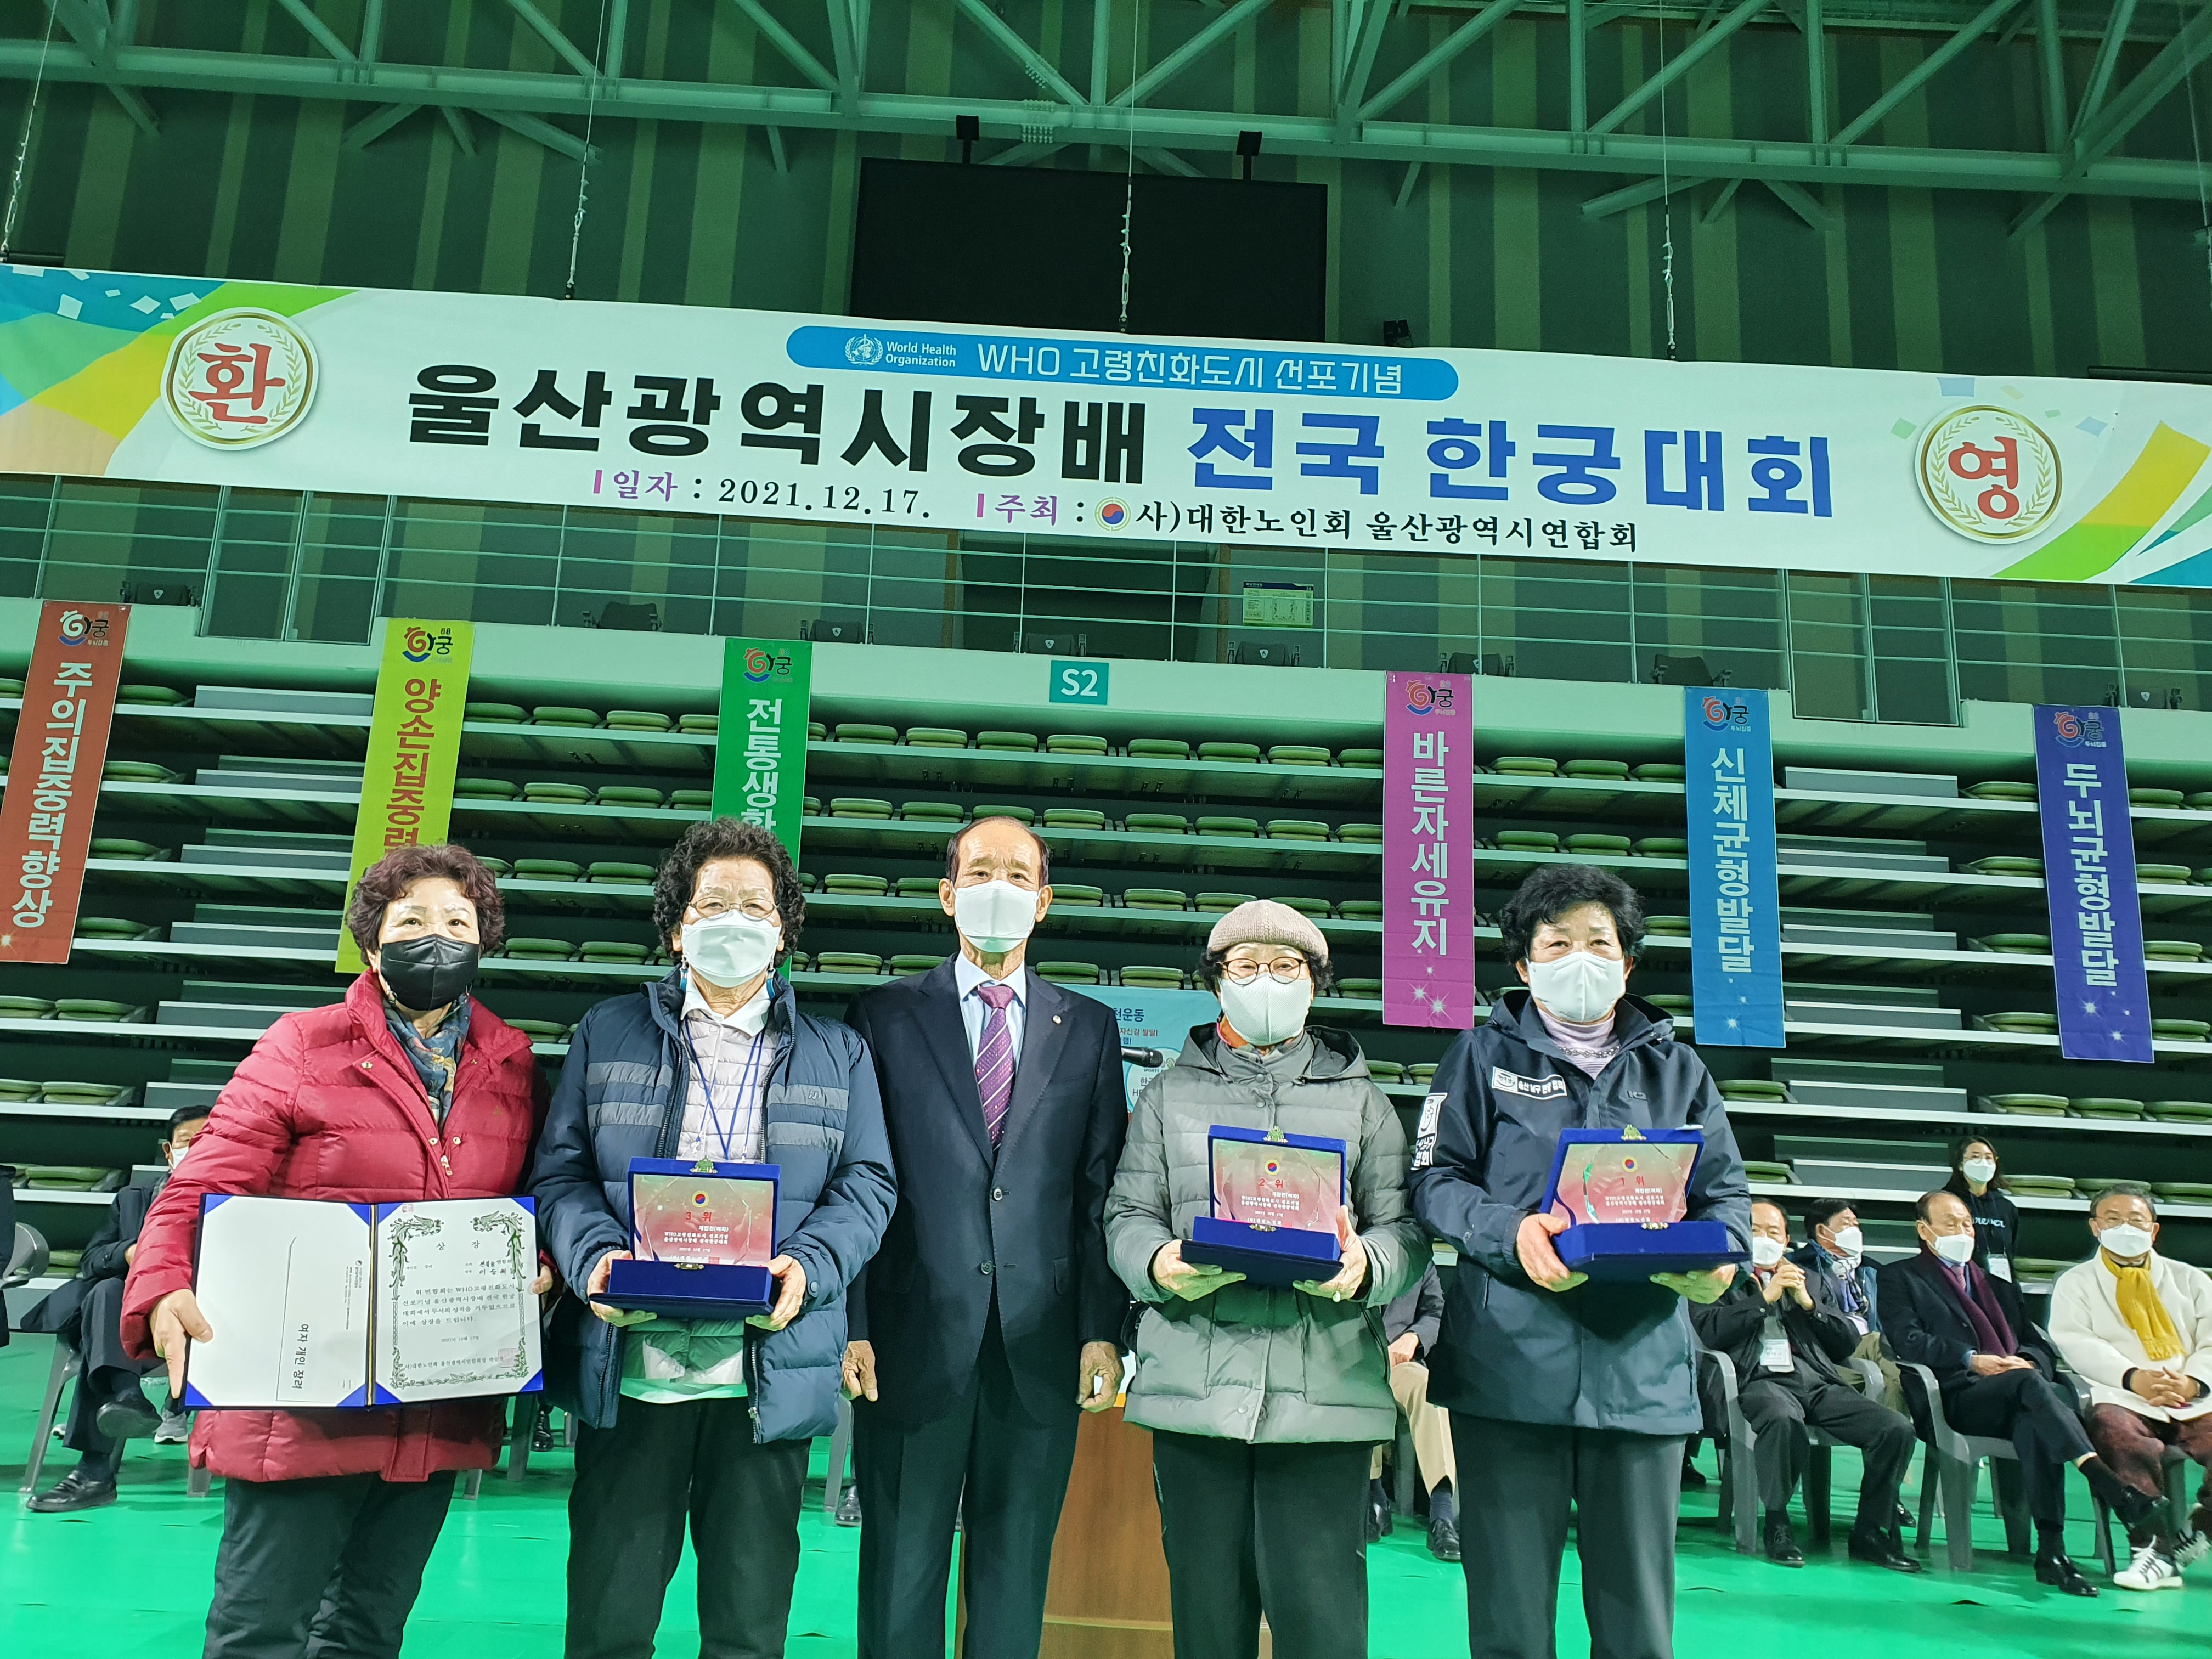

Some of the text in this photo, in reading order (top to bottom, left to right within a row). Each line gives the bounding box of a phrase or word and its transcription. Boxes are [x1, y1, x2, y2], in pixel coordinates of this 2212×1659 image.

[885, 353, 956, 368] Organization
[886, 341, 956, 356] World Health
[978, 343, 1402, 394] WHO 고령친화도시 선포기념
[188, 341, 286, 425] 환
[408, 364, 1834, 517] 울산광역시장배 전국 한궁대회
[613, 470, 679, 503] 일자
[718, 478, 930, 518] 2021.12.17.
[1948, 435, 2022, 521] 영
[994, 494, 1058, 526] 주최
[1135, 500, 1351, 540] 사)대한노인회
[1365, 510, 1637, 553] 울산광역시연합회
[1060, 668, 1098, 697] S2
[12, 662, 93, 928] 주의집중력향상
[1410, 731, 1449, 956] 바른자세유지
[1711, 747, 1754, 973] 신체균형발달
[2063, 763, 2119, 988] 두뇌균형발달
[1275, 1179, 1283, 1189] 위
[685, 1211, 712, 1222] 3 위
[292, 1324, 309, 1389] 여자 개인 장려
